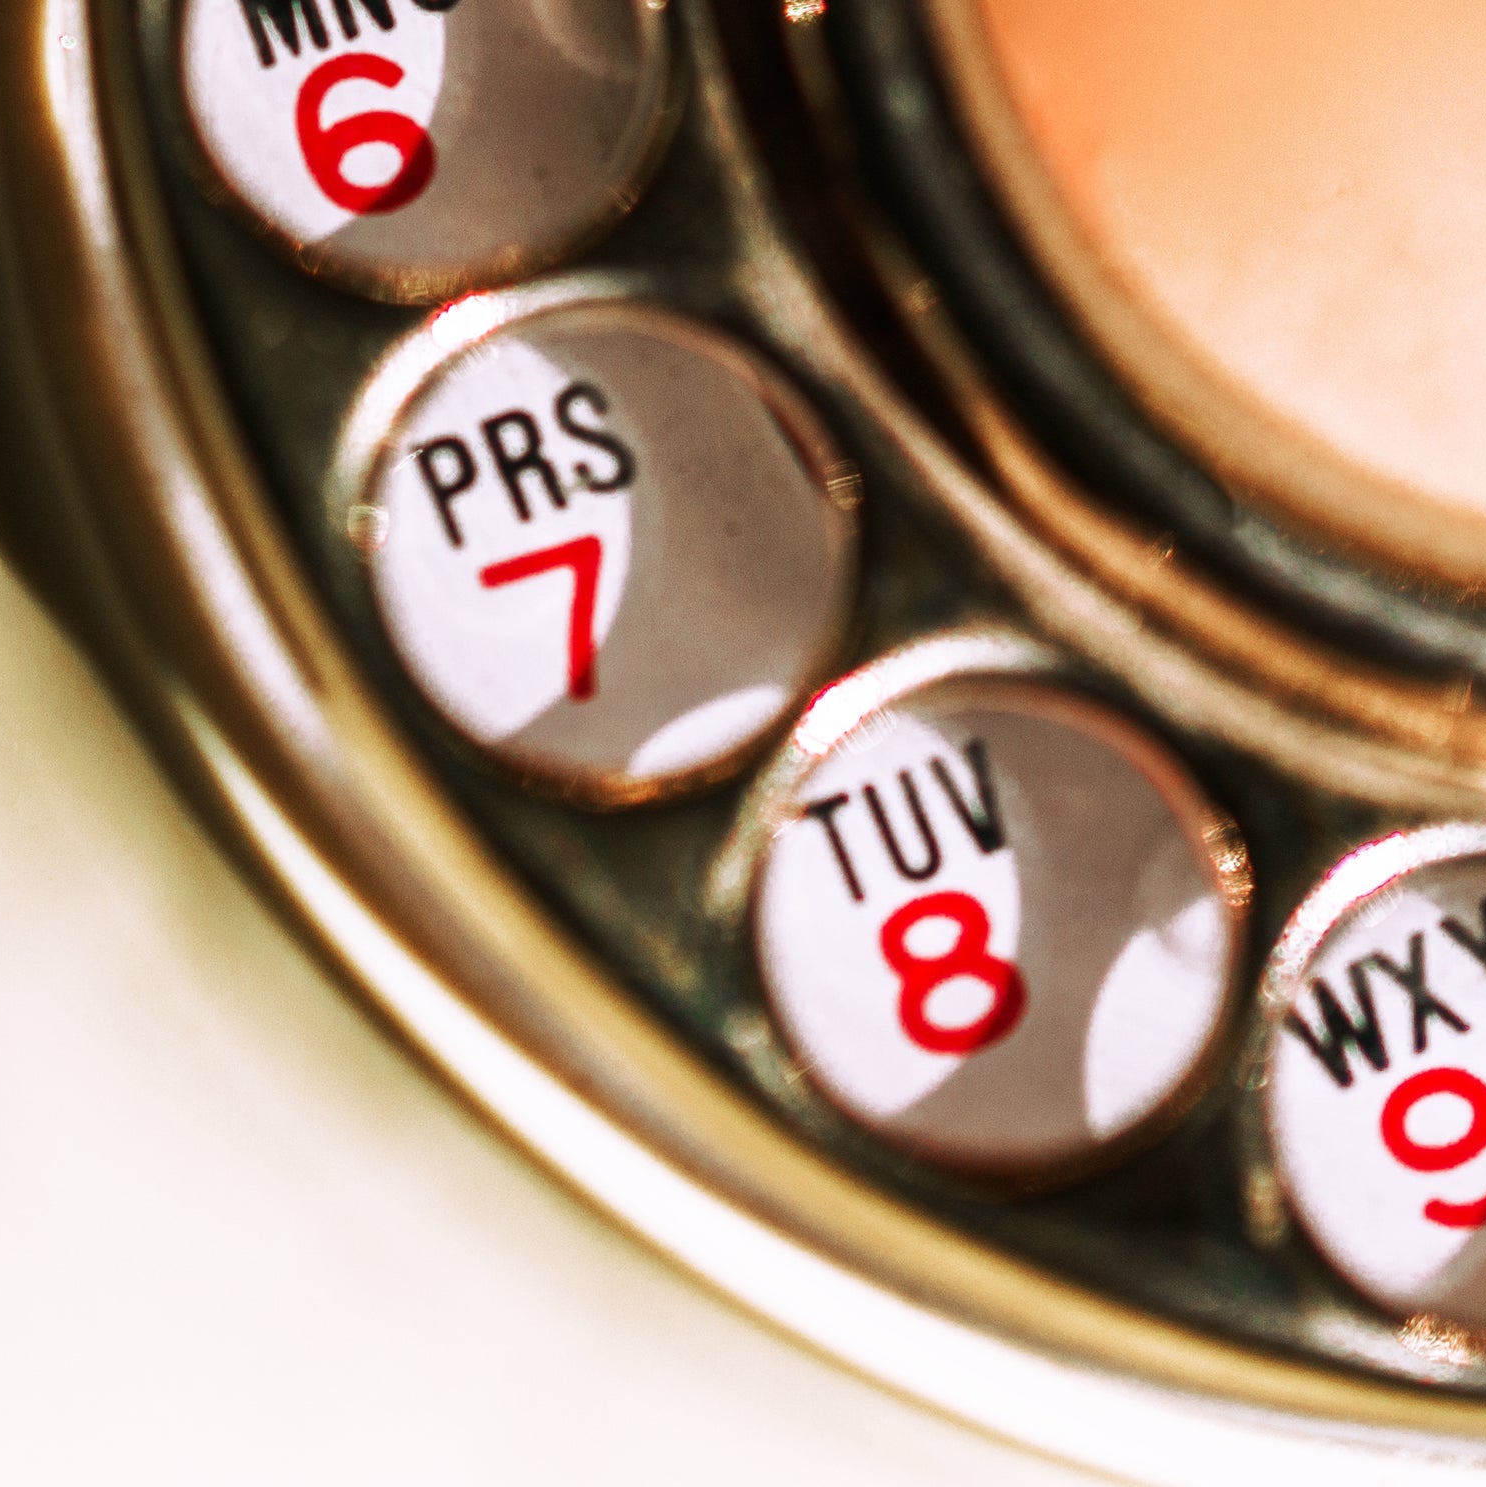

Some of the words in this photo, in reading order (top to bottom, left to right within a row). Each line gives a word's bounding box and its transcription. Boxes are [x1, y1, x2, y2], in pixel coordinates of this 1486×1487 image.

[293, 52, 435, 218] 6
[417, 381, 637, 544] PRS
[477, 533, 605, 702] 7
[801, 736, 1006, 898] TUV
[878, 889, 1027, 1059] 8
